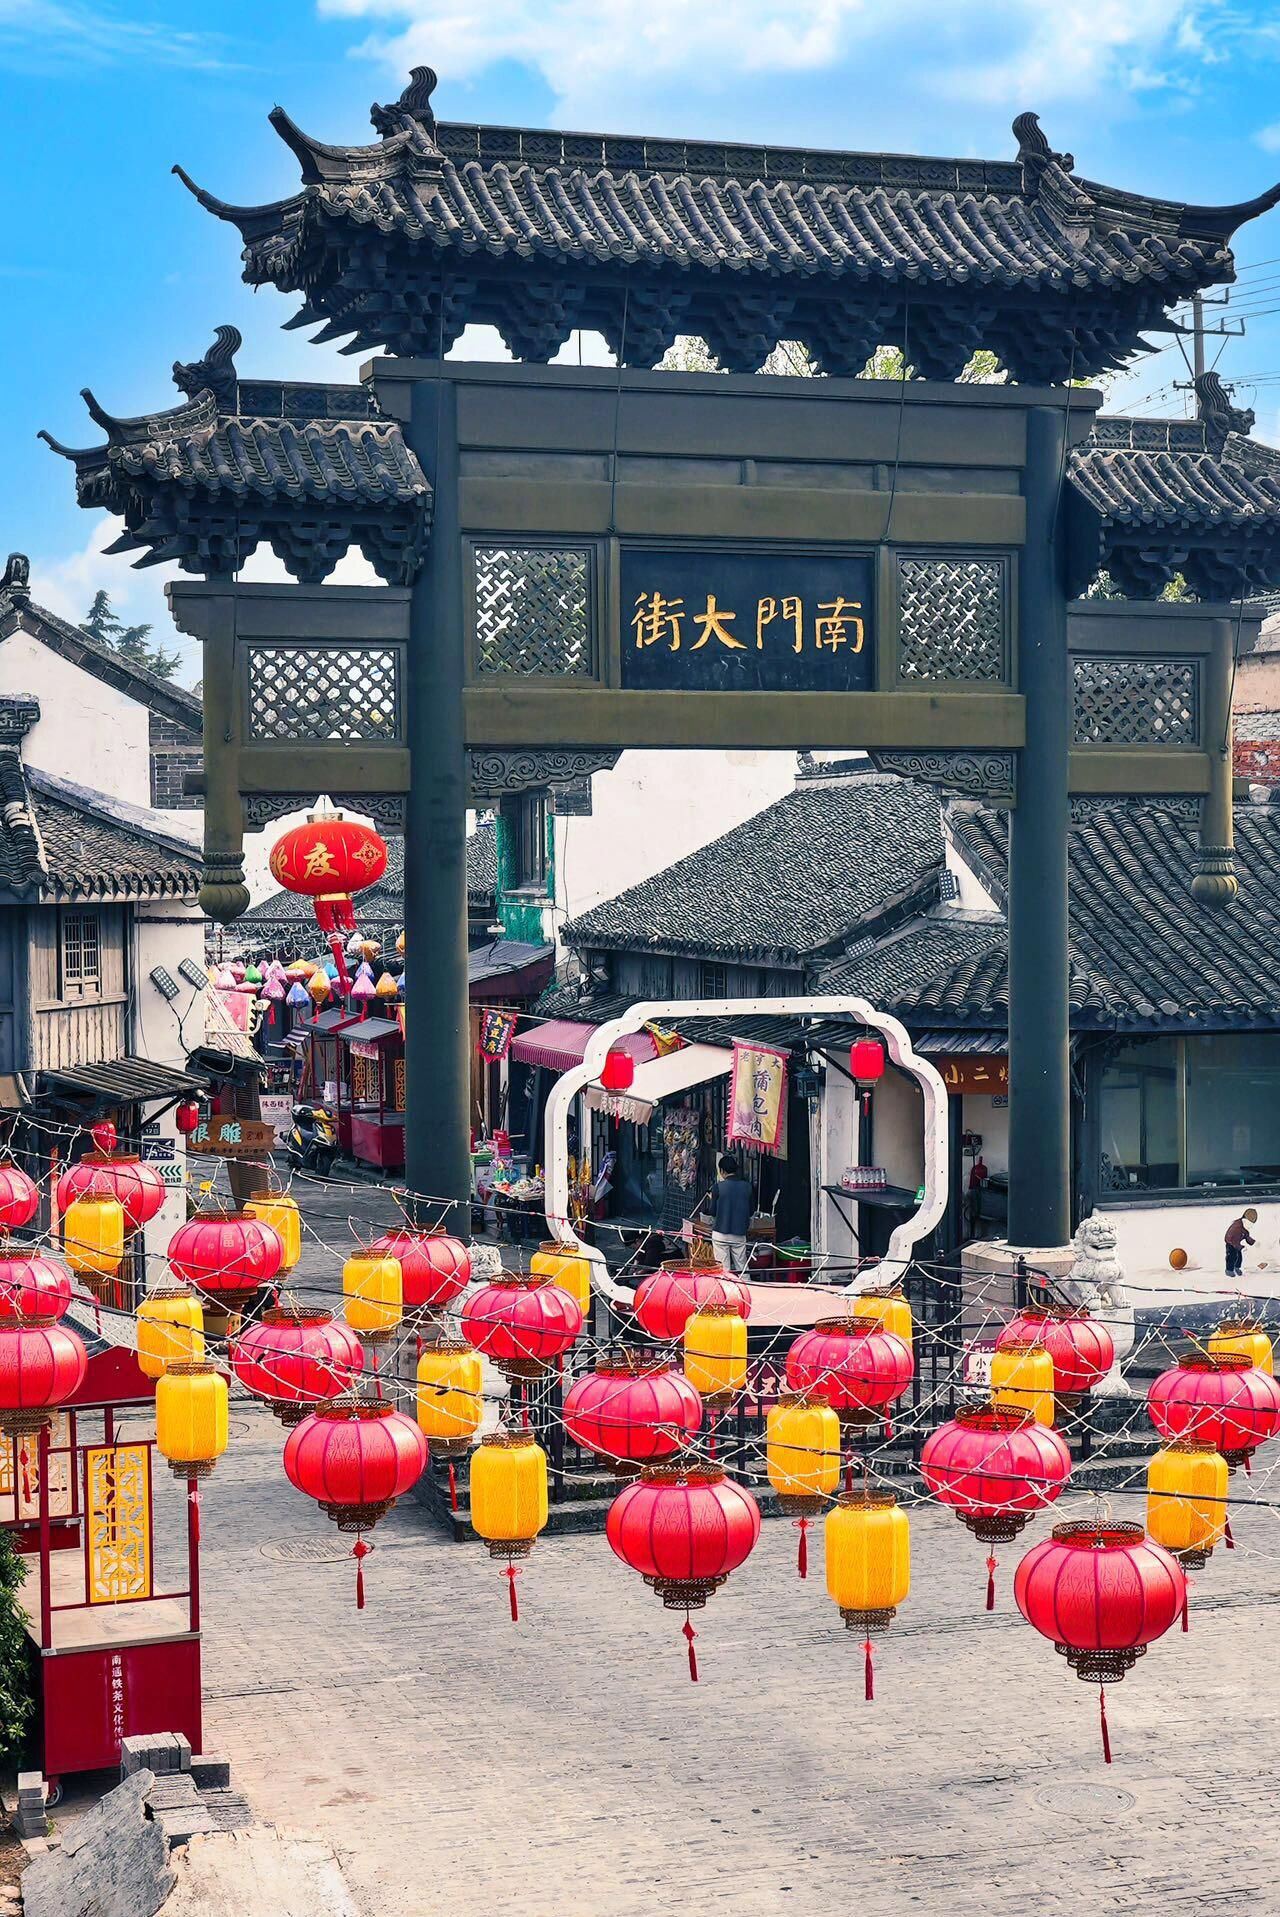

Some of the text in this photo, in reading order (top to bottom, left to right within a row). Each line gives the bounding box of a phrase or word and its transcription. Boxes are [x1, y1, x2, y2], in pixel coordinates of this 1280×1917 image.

[751, 1070, 772, 1138] 蒲包肉
[976, 1357, 992, 1369] 小
